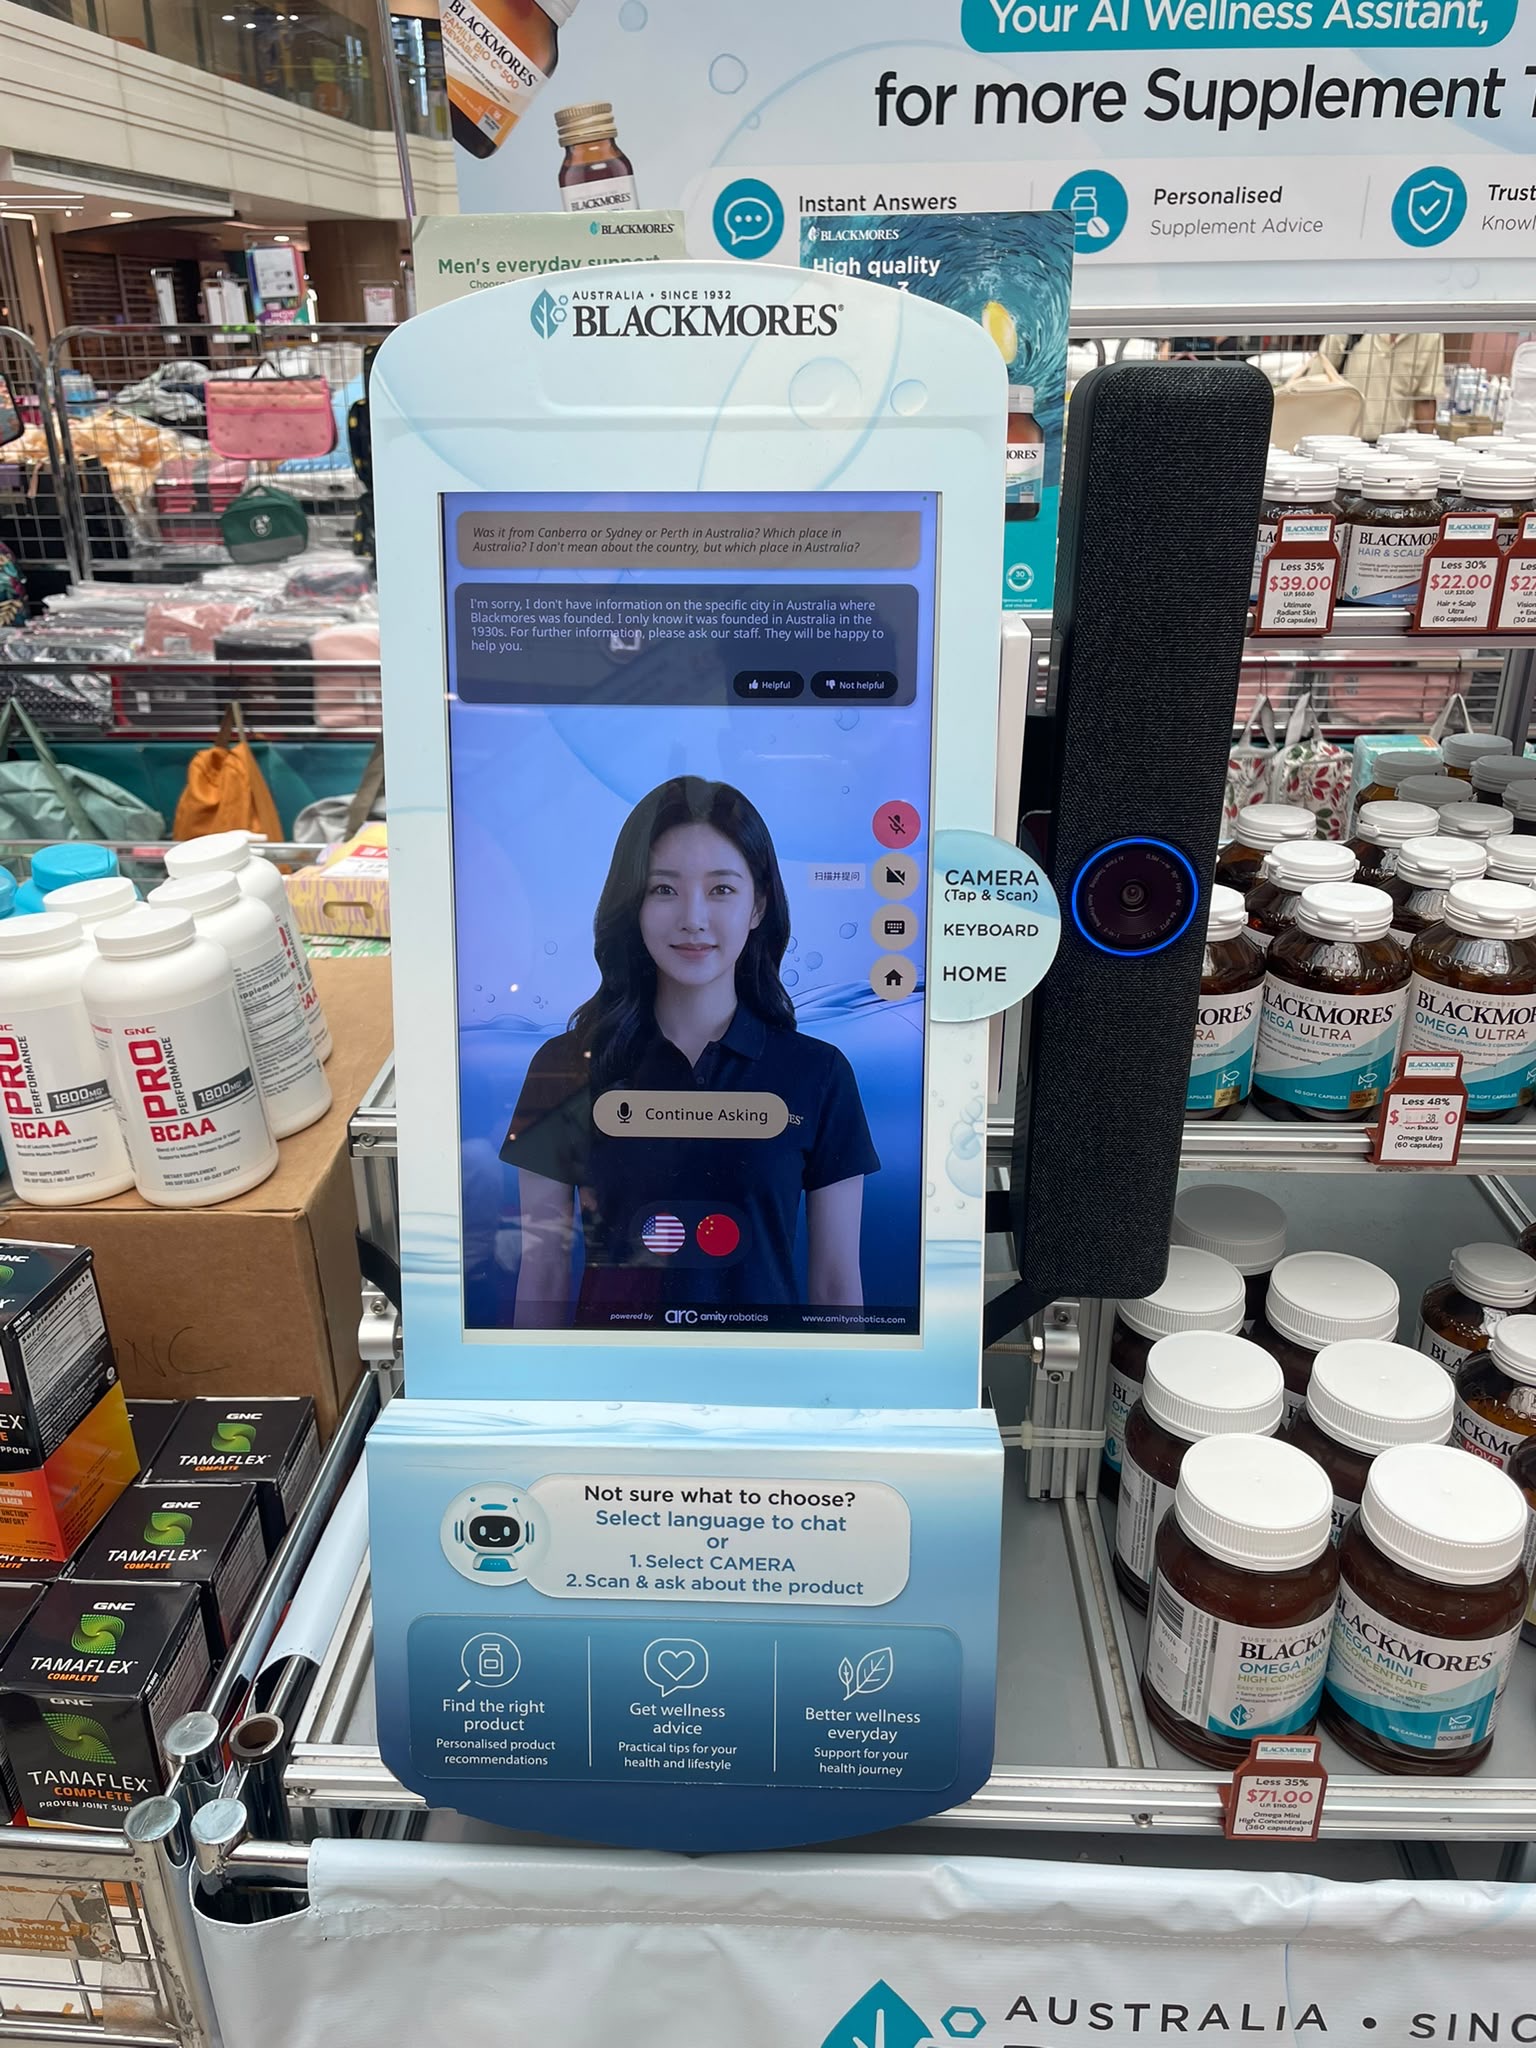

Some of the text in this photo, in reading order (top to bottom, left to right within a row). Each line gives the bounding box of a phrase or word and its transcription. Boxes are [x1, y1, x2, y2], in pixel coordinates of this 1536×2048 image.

[993, 0, 1489, 36] Your AI Wellness Assitant,
[442, 11, 520, 90] FAMILY BIO 500
[449, 0, 537, 88] BLACKMORES
[875, 71, 957, 128] for
[974, 80, 1126, 125] more
[1144, 64, 1507, 132] Supplement
[1153, 186, 1283, 206] Personalised
[1488, 183, 1536, 202] Trust
[570, 192, 632, 212] BLACKMORES
[799, 193, 958, 213] Instant Answers
[601, 223, 676, 235] BLACKMORES
[820, 228, 900, 241] BLACKMORES
[1150, 215, 1324, 238] Supplement Advice
[438, 257, 490, 275] Men's
[496, 256, 582, 274] everyday
[812, 255, 941, 278] High quality
[572, 289, 732, 301] AUSTRALIA SINCE 1932
[1358, 547, 1425, 558] HAIR & SCALP
[1281, 562, 1325, 571] Less 35%
[1441, 560, 1487, 570] Less 30%
[1268, 576, 1332, 592] $39.00
[1430, 574, 1492, 591] $22.00
[470, 599, 876, 613] I'm sorry, I don't have information on the specific city in Australia where
[1458, 600, 1477, 608] Scalp
[1273, 617, 1318, 625] (30 capsules)
[1432, 615, 1478, 624] (60 capsules)
[762, 680, 791, 691] Helpful
[839, 680, 885, 691] Not helpful
[945, 869, 1040, 887] CAMERA
[944, 888, 1039, 903] (Tap & Scan)
[943, 923, 1039, 938] KEYBOARD
[943, 966, 1008, 983] HOME
[124, 1025, 157, 1036] GNC
[1300, 1024, 1353, 1041] ULTRA
[1415, 1011, 1526, 1041] OMEGA ULTRA
[17, 1035, 45, 1115] PERFORMANCE
[128, 1038, 178, 1119] PRO
[160, 1036, 190, 1116] PERFORMANCE
[1401, 1097, 1451, 1106] Less 48%
[645, 1106, 714, 1122] Continue
[717, 1106, 769, 1125] Asking
[11, 1119, 72, 1140] BCAA
[150, 1116, 218, 1143] BCAA
[1397, 1134, 1443, 1143] Omega Ultra
[610, 1309, 906, 1325] powered by arc amity robotics www.amityrobotics.com
[226, 1412, 264, 1420] GNC
[178, 1453, 268, 1467] TAMAFLEX
[194, 1465, 240, 1473] COMPLETE
[584, 1485, 856, 1508] Not sure what to choose?
[161, 1501, 201, 1510] GNC
[595, 1509, 847, 1532] Select language to chat
[706, 1536, 729, 1549] or
[107, 1548, 204, 1563] TAMAFLEX
[629, 1554, 796, 1572] 1. Select CAMERA
[123, 1561, 173, 1570] COMPLETE
[566, 1573, 864, 1596] 2. Scan & ask about the product
[93, 1601, 136, 1611] GNC
[30, 1656, 132, 1675] TAMAFLEX
[1239, 1660, 1301, 1675] OMEGA
[1376, 1652, 1414, 1678] MINI
[47, 1672, 101, 1683] COMPLETE
[49, 1697, 94, 1707] GNC
[442, 1698, 546, 1717] Find the right
[629, 1702, 726, 1718] Get wellness
[805, 1707, 921, 1724] Better wellness
[464, 1717, 525, 1733] product
[652, 1721, 703, 1736] advice
[827, 1727, 898, 1744] everyday
[436, 1738, 556, 1751] Personalised product
[444, 1754, 549, 1767] recommendations
[27, 1770, 150, 1794] TAMAFLEX
[1256, 1778, 1309, 1787] Less 35%
[53, 1785, 133, 1803] COMPLETE
[1247, 1788, 1314, 1803] $71.00
[39, 1800, 80, 1810] PROVEN
[82, 1801, 109, 1810] JOINT
[1238, 1818, 1313, 1826] High Concentrated
[1253, 1811, 1282, 1819] Omega
[1003, 1994, 1536, 2044] AUSTRALIA SINC
